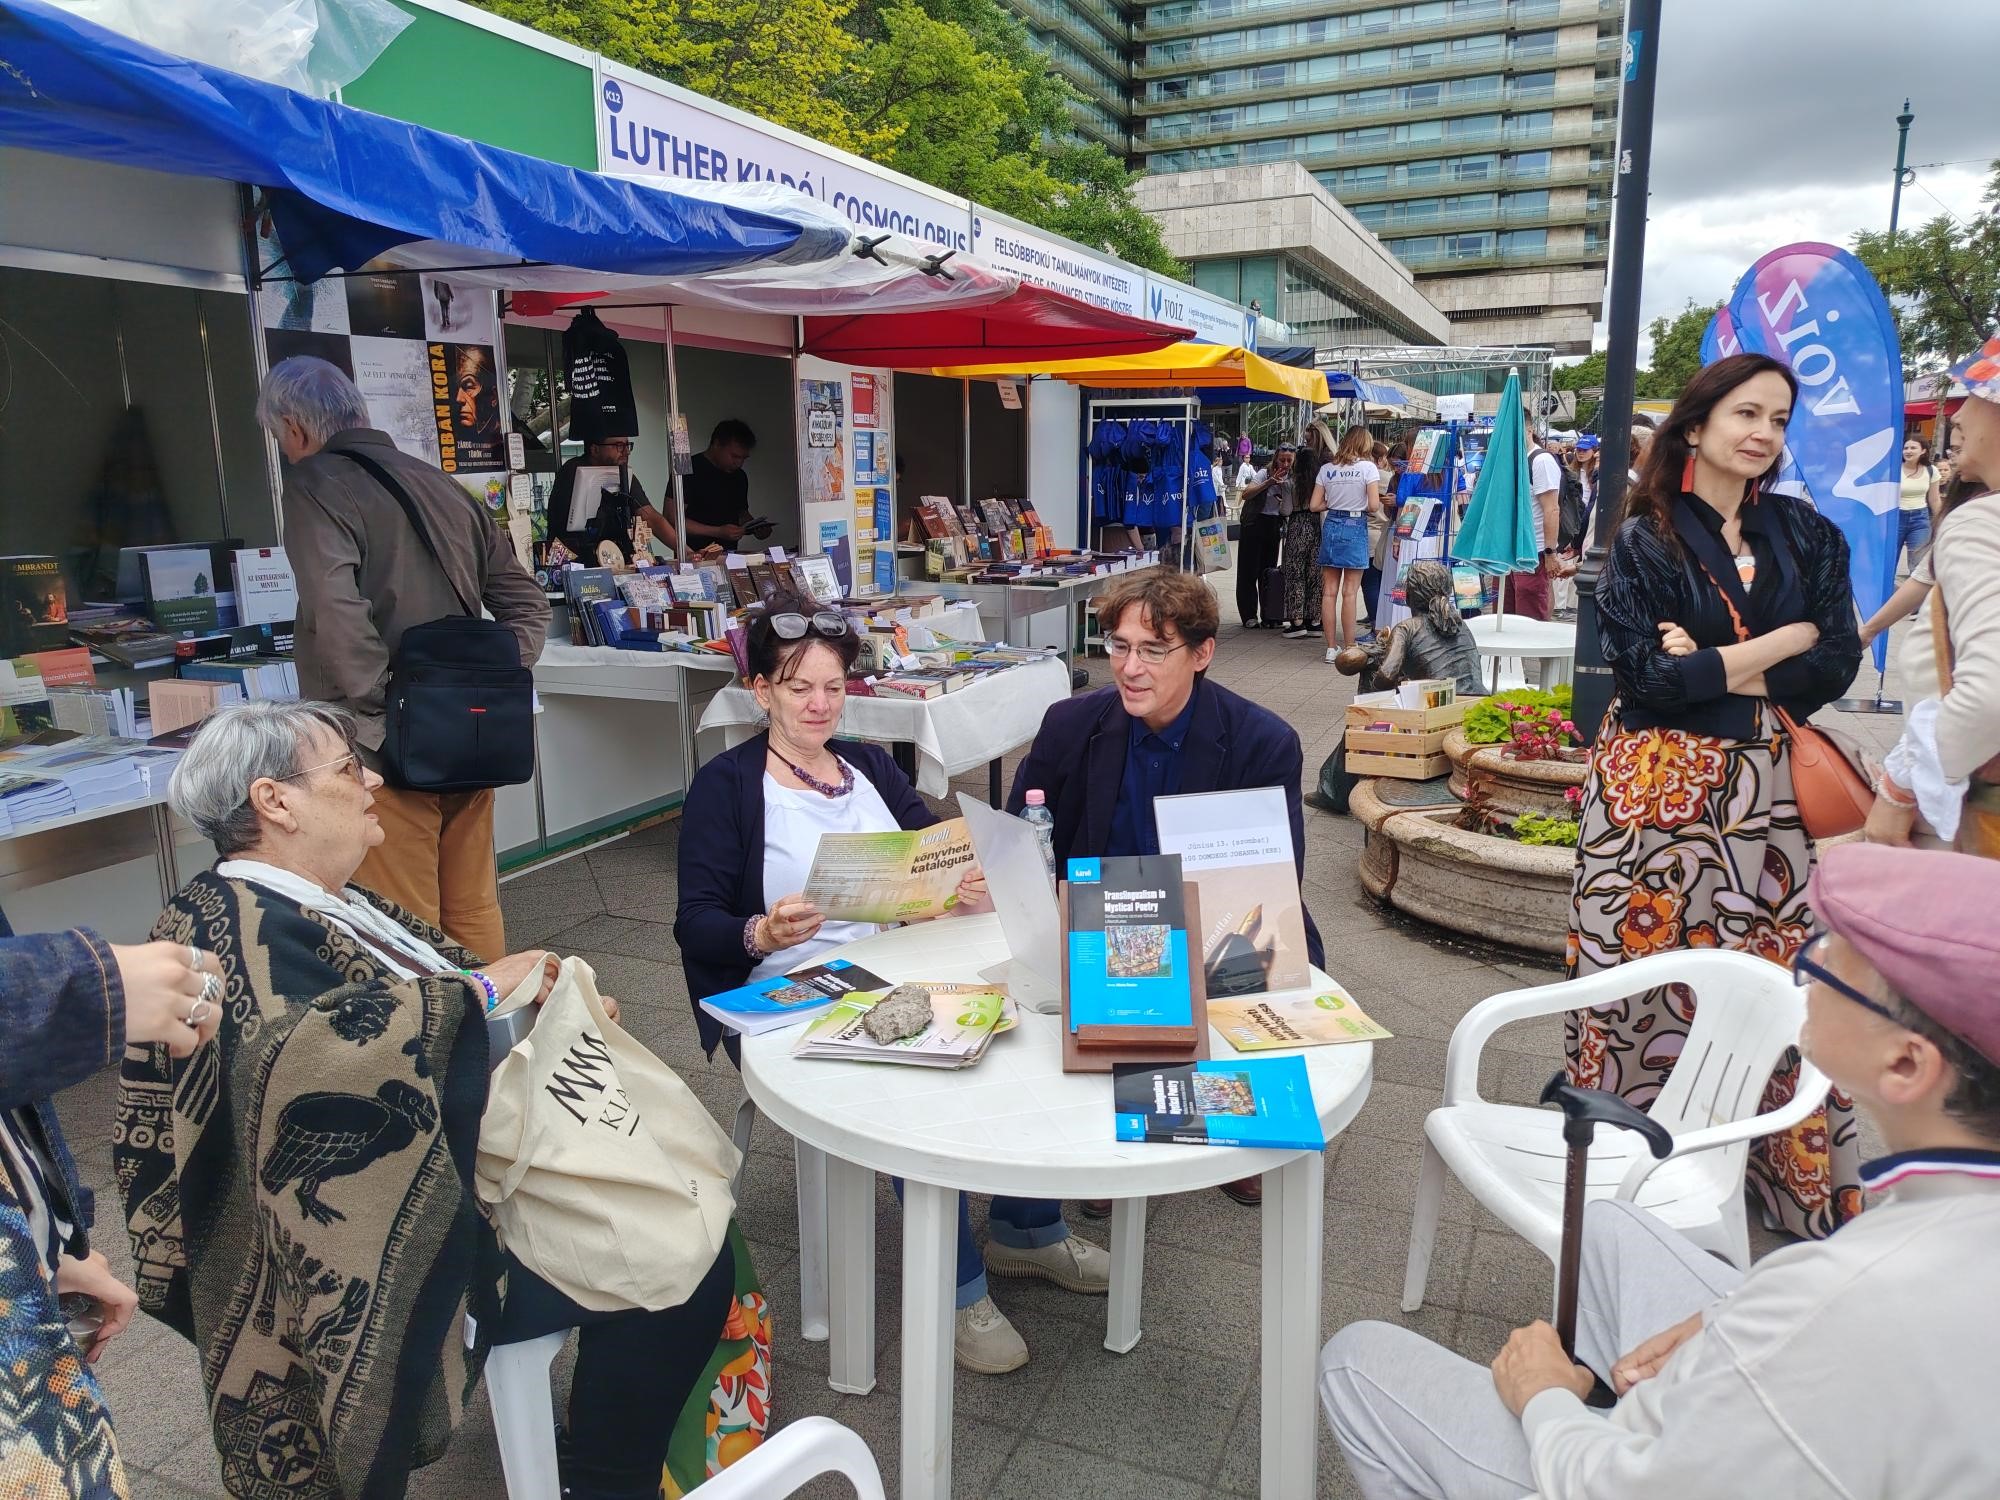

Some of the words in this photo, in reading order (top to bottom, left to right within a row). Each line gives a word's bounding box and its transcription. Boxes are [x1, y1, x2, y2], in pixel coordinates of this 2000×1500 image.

[605, 89, 621, 104] K12
[609, 114, 728, 183] LUTHER
[994, 236, 1051, 270] FELSŐBBFOKÚ
[1051, 256, 1101, 287] TANULMÁNYOK
[1102, 271, 1128, 294] INTÉZETE
[429, 343, 450, 400] KORA
[14, 562, 60, 571] MBRANDT
[911, 853, 975, 875] katalógusa
[1104, 889, 1158, 901] Translingualism
[1158, 888, 1166, 899] in
[1104, 902, 1134, 913] Mystical
[1134, 902, 1159, 913] Poetry
